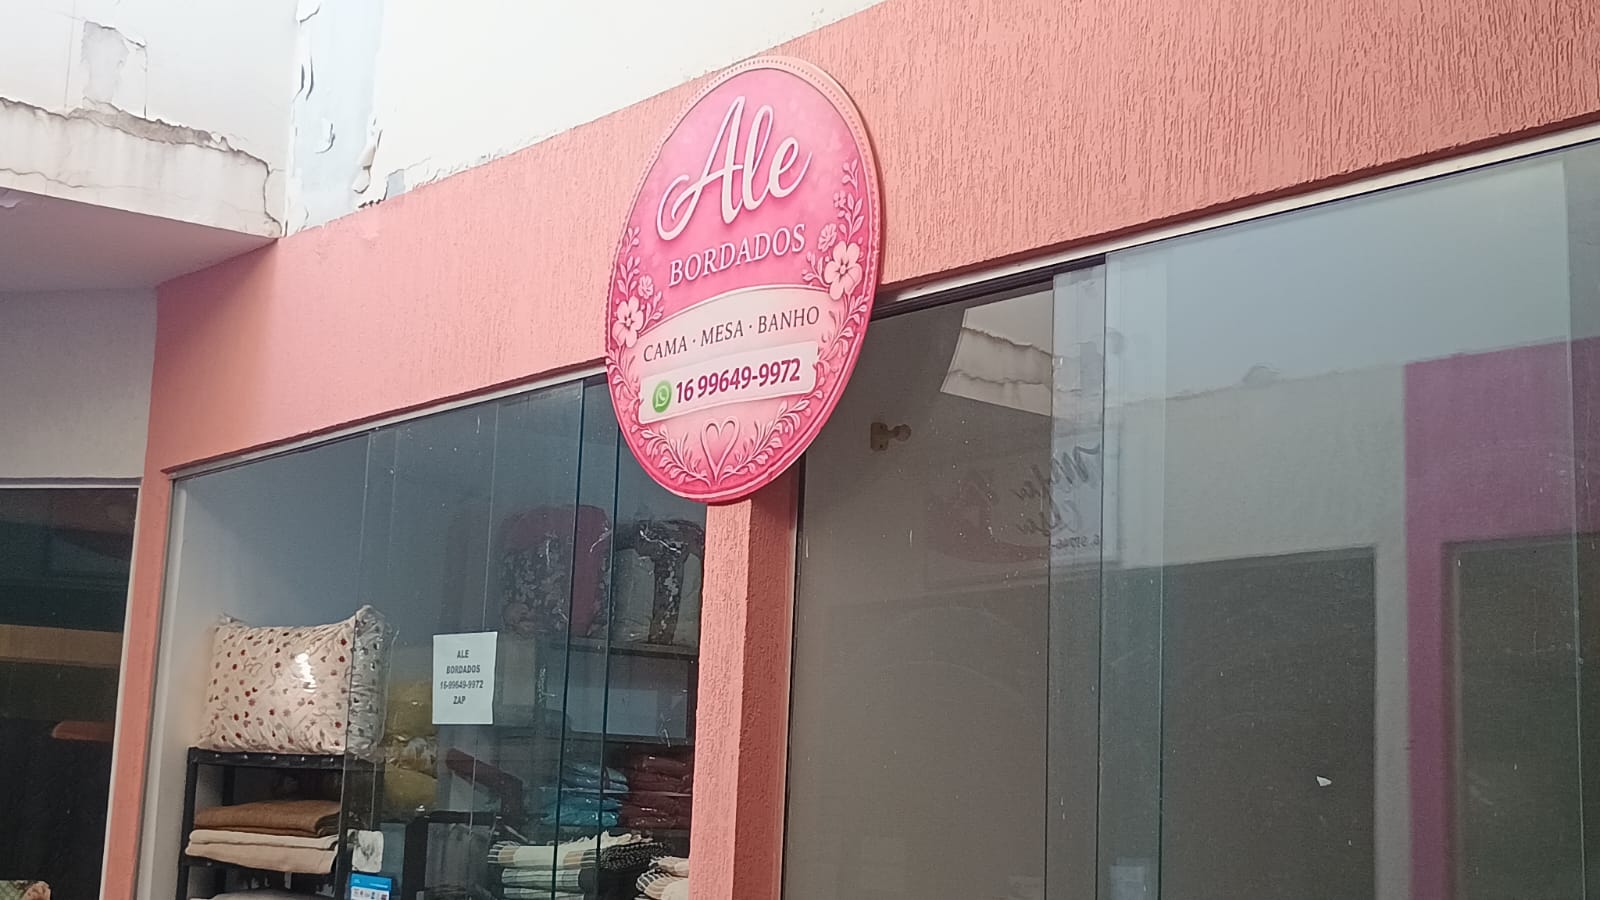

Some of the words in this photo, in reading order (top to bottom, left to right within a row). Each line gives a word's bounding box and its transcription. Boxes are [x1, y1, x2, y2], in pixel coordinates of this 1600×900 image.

[656, 95, 813, 241] Ale
[668, 223, 806, 287] BORDADOS
[643, 336, 688, 362] CAMA
[700, 320, 744, 347] MESA
[758, 306, 820, 334] BANHO
[676, 378, 694, 403] 16
[697, 358, 801, 398] 99649-9972
[446, 664, 481, 674] BORDADOS
[457, 649, 470, 658] ALE
[453, 696, 466, 704] ZAP
